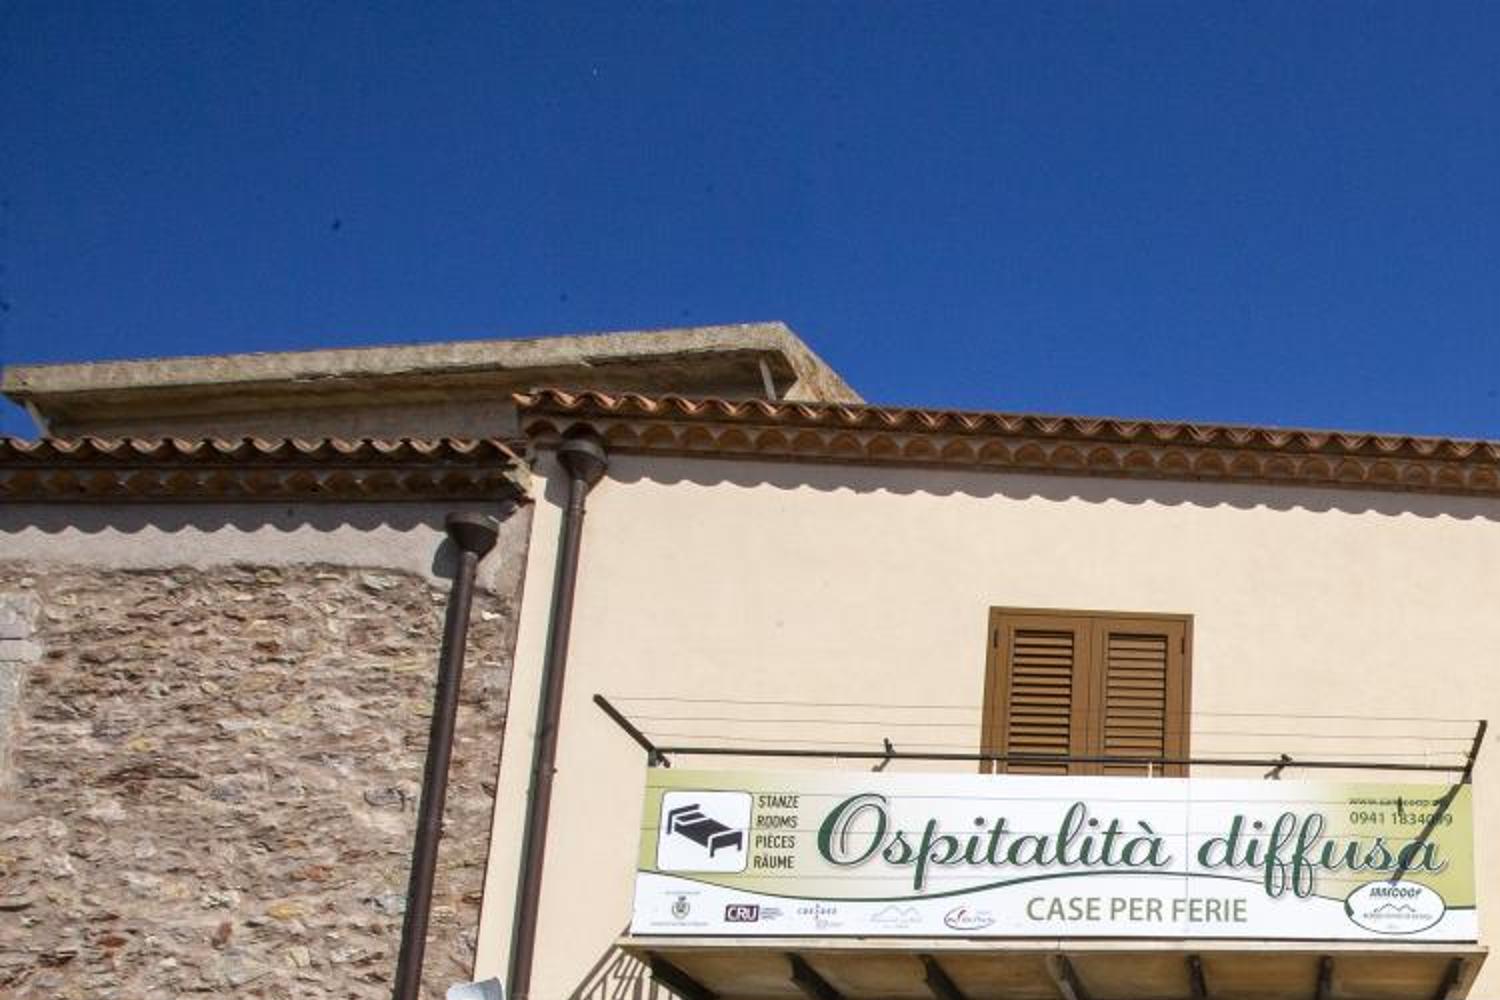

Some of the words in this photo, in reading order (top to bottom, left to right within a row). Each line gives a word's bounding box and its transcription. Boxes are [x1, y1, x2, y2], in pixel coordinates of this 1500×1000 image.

[758, 795, 800, 809] STANZE
[756, 815, 798, 829] ROOMS
[1349, 811, 1385, 825] 0941
[817, 792, 1171, 891] Ospitalità
[1198, 811, 1446, 898] diffusa
[727, 906, 758, 921] CRU
[1026, 896, 1100, 921] CASE
[1110, 897, 1164, 922] PER
[1172, 898, 1248, 923] FERIE
